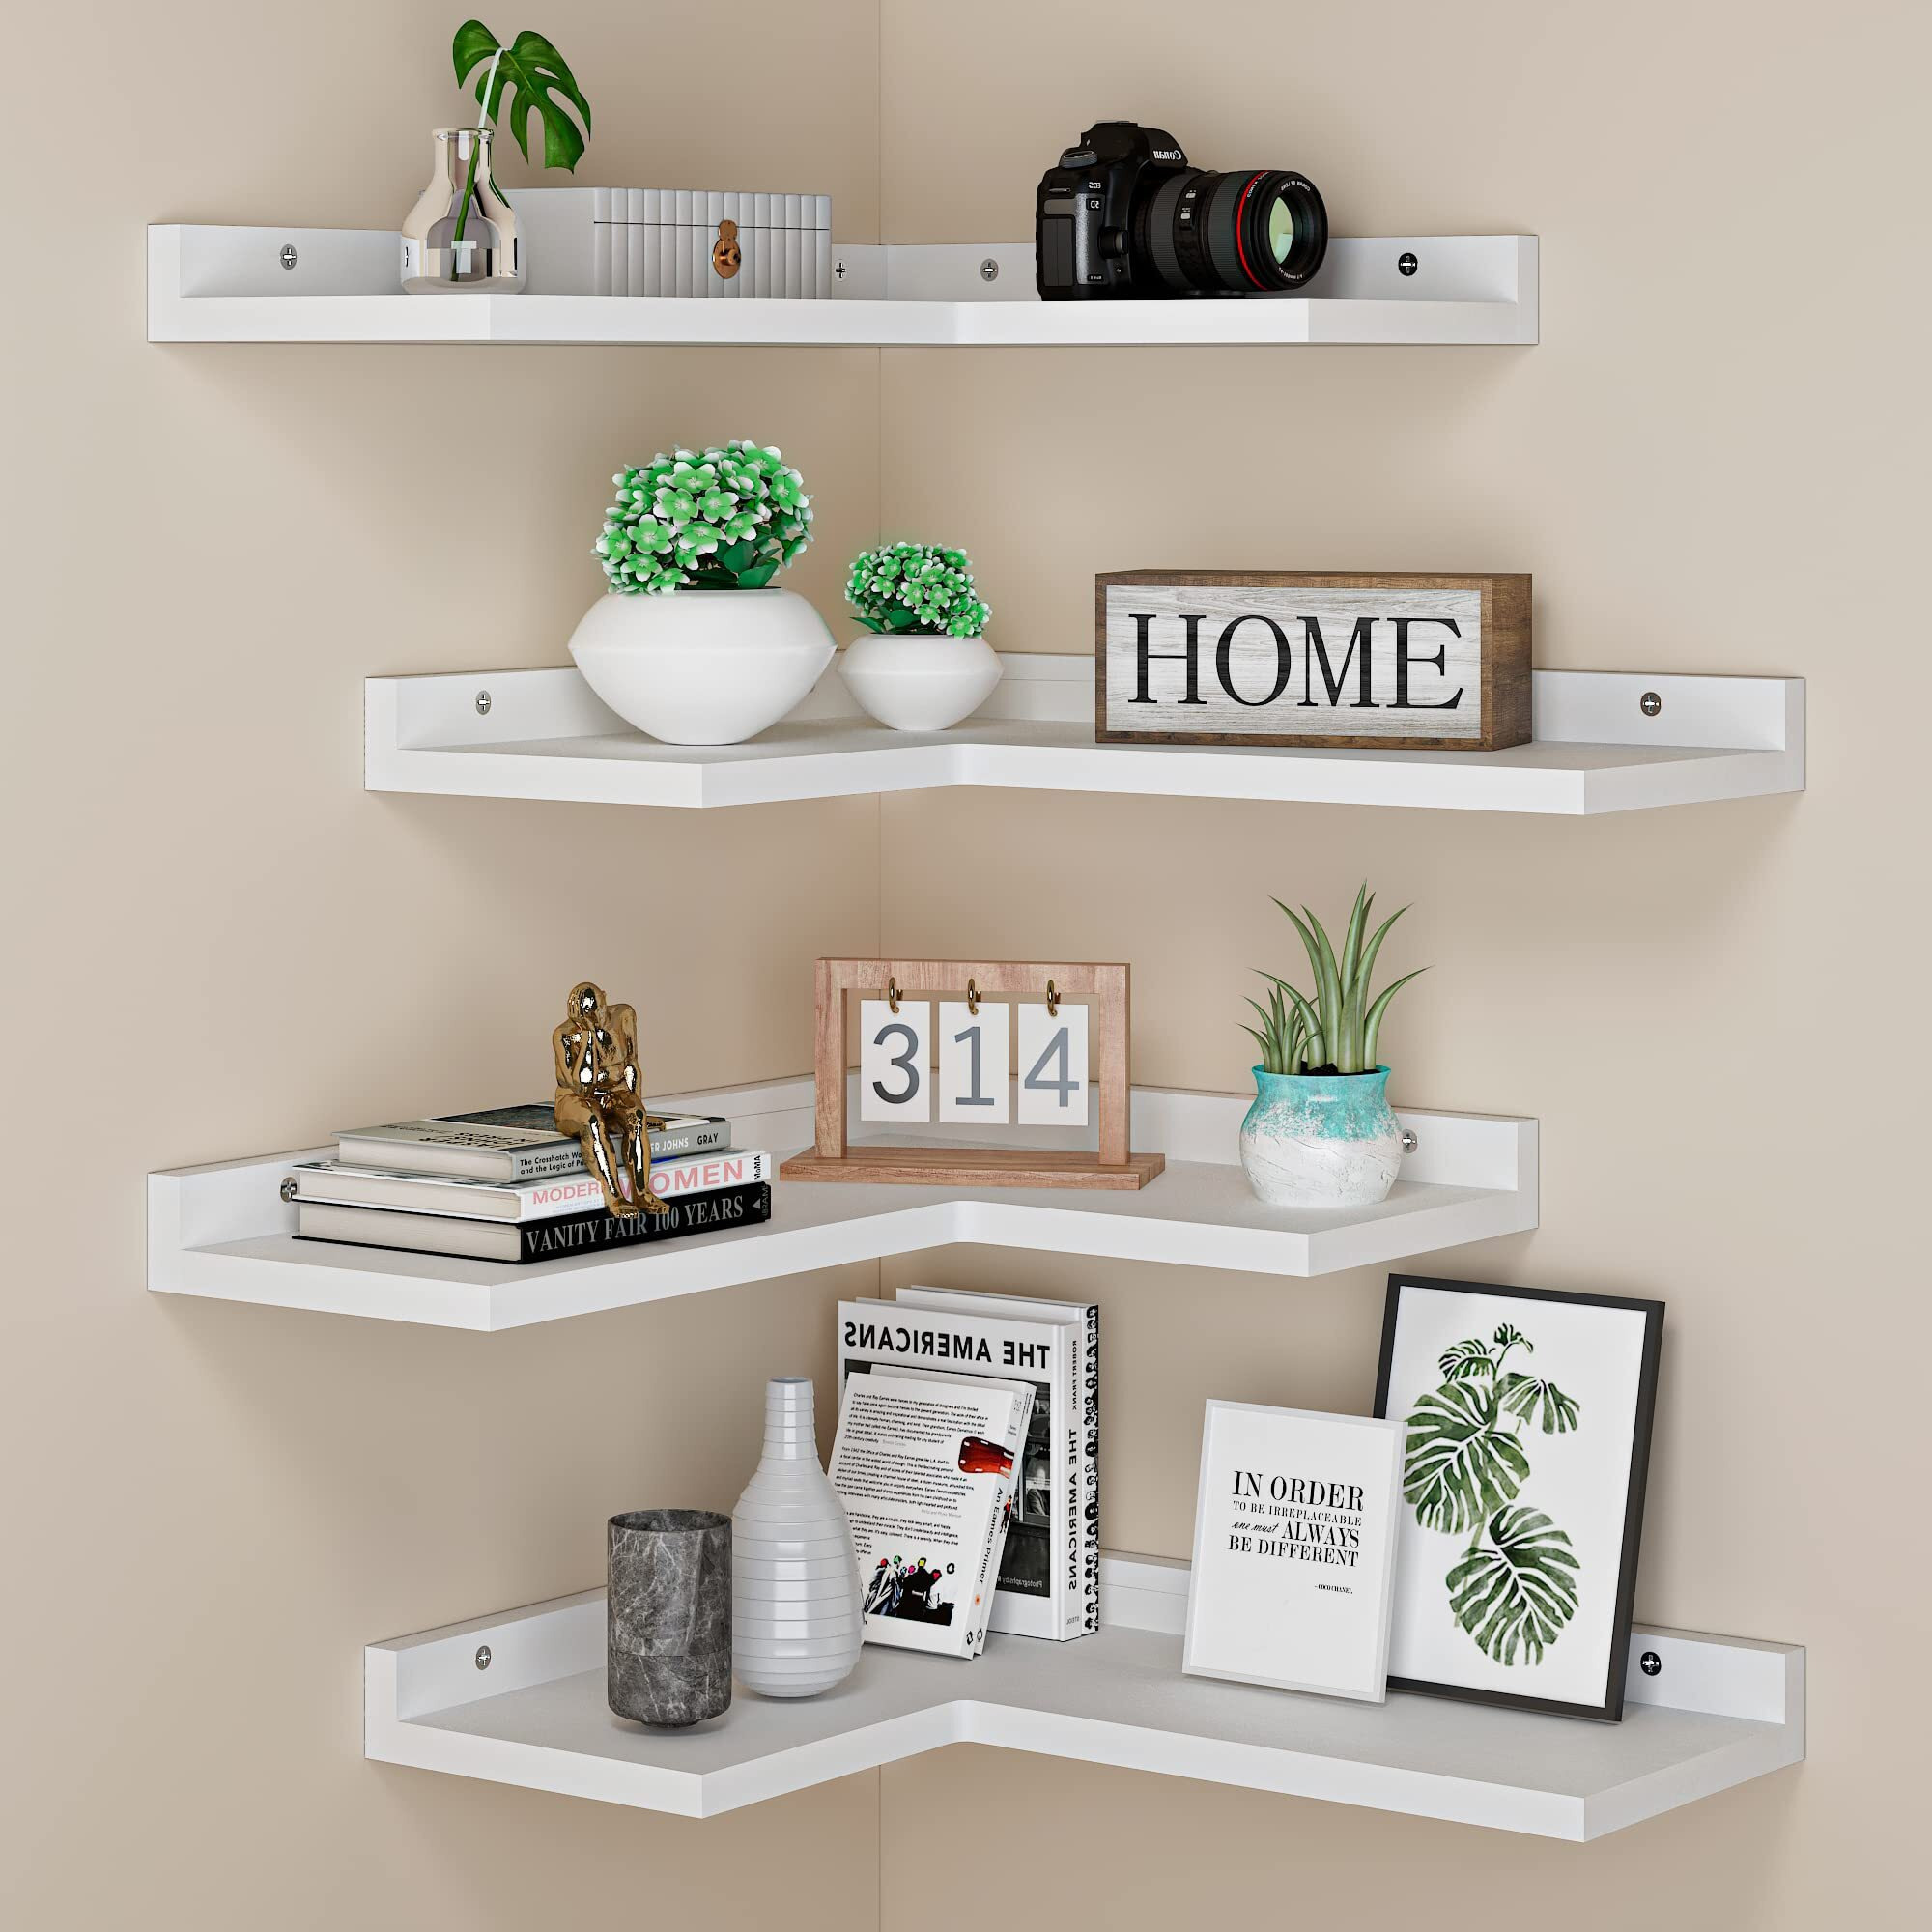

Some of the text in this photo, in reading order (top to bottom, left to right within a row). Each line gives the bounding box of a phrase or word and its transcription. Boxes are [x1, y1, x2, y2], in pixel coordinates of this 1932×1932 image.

[1127, 613, 1463, 710] HOME
[872, 1023, 1080, 1107] 3 1 4
[662, 1137, 689, 1151] JOHNS
[697, 1132, 719, 1146] GRAY
[534, 1151, 570, 1165] Crosshatch
[536, 1164, 547, 1173] the
[549, 1161, 566, 1172] Logic
[532, 1181, 603, 1205] MODER
[526, 1195, 744, 1253] VANITY FAIR 100 YEARS
[1232, 1470, 1364, 1512] IN ORDER
[1233, 1500, 1362, 1527] TO BE IRREPLACEABLE
[980, 1487, 1004, 1584] An Eames Primer
[1231, 1520, 1360, 1548] one must ALWAYS
[1228, 1534, 1359, 1567] BE DIFFERENT
